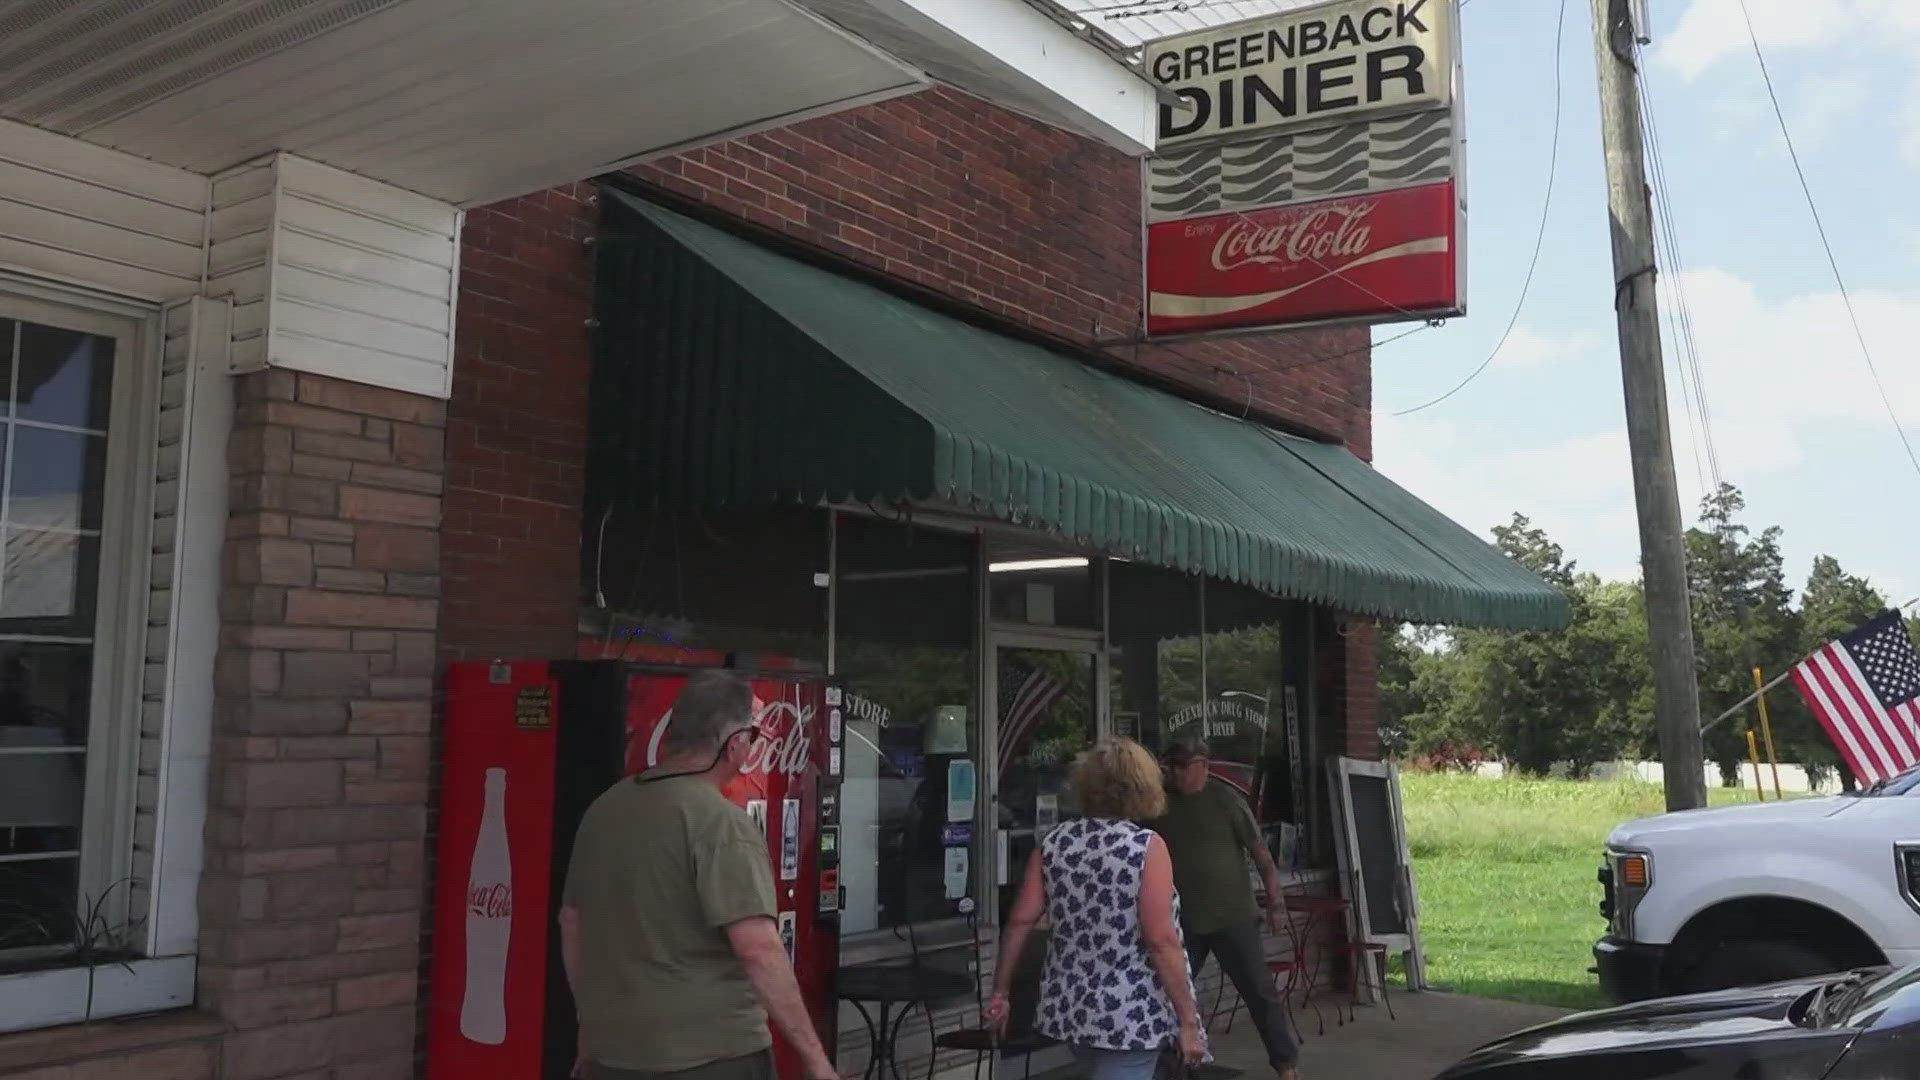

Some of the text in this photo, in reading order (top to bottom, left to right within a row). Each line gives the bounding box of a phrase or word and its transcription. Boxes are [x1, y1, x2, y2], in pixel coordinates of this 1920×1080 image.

[1152, 0, 1429, 84] GREENBACK
[1159, 45, 1426, 140] DINER
[1211, 200, 1379, 271] Coca-Cola
[845, 692, 892, 729] STORE
[1168, 699, 1218, 733] GREENBCK
